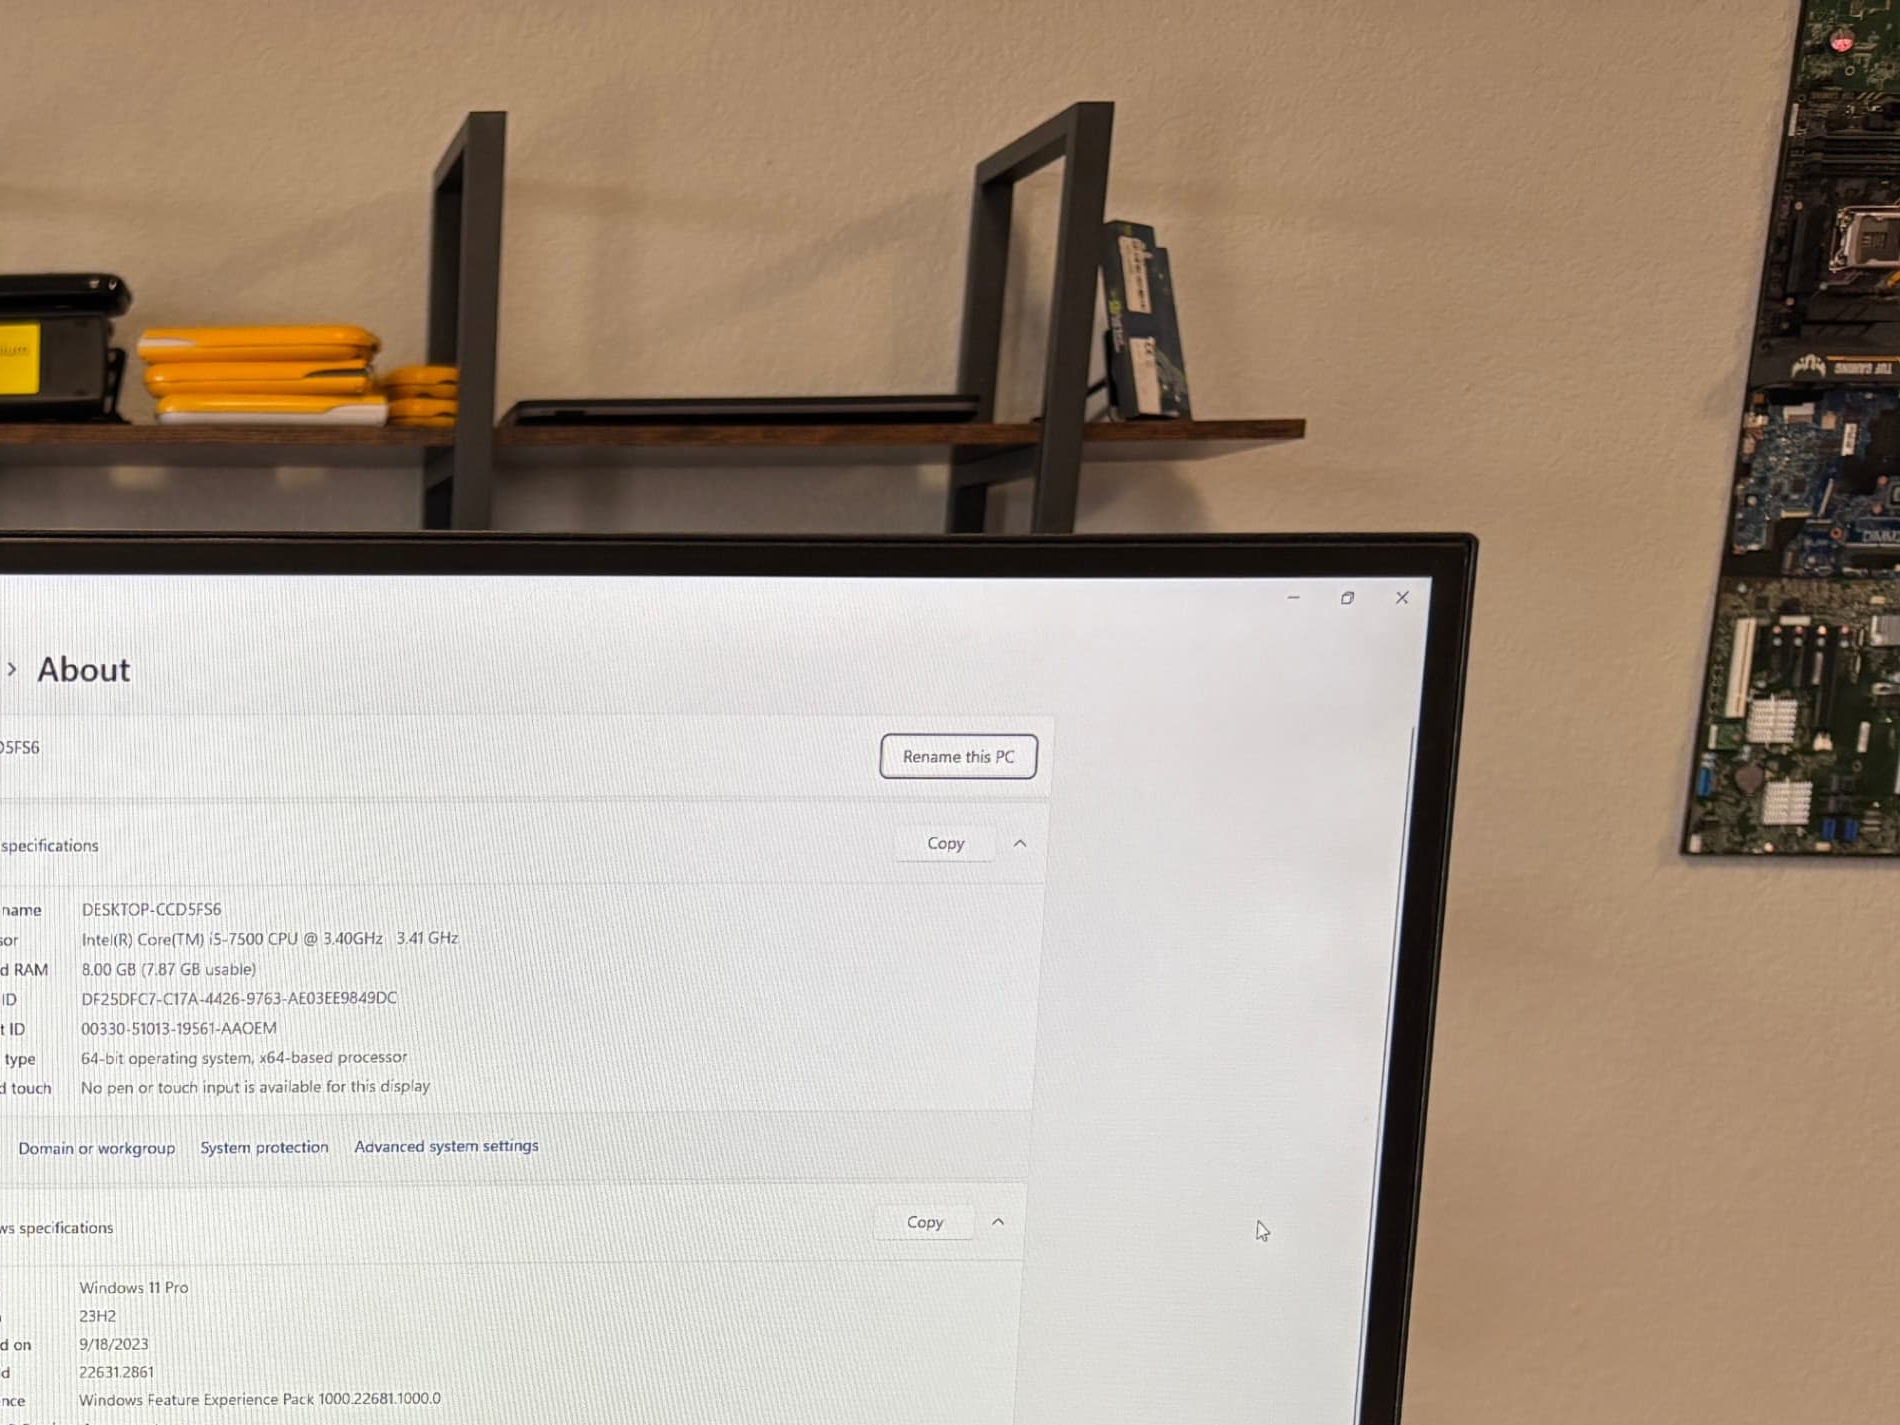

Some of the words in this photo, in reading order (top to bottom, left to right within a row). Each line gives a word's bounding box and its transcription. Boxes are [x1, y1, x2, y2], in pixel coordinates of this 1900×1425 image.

[37, 654, 131, 683] About
[902, 749, 962, 764] Rename
[965, 749, 992, 764] this
[995, 749, 1015, 764] PC
[0, 837, 99, 856] specifications
[927, 835, 966, 854] Copy
[2, 906, 43, 917] name
[82, 901, 223, 917] DESKTOP-CCD5FS6
[82, 932, 133, 949] Intel(R)
[137, 932, 205, 949] Core(TM)
[209, 931, 265, 946] i5-7500
[267, 931, 299, 946] CPU
[303, 931, 319, 948] @
[324, 931, 384, 946] 3.40GHz
[397, 930, 424, 946] 3.41
[427, 930, 459, 945] GHz
[1, 992, 18, 1007] ID
[9, 1021, 26, 1037] ID
[78, 1280, 145, 1295] Windows
[148, 1280, 161, 1294] 11
[164, 1280, 189, 1294] Pro
[79, 1309, 117, 1324] 23H2
[12, 1341, 32, 1352] on
[79, 1337, 149, 1352] 9/18/2023
[78, 1394, 144, 1407] Windows
[147, 1392, 200, 1407] Feature
[203, 1392, 279, 1409] Experience
[282, 1392, 315, 1406] Pack
